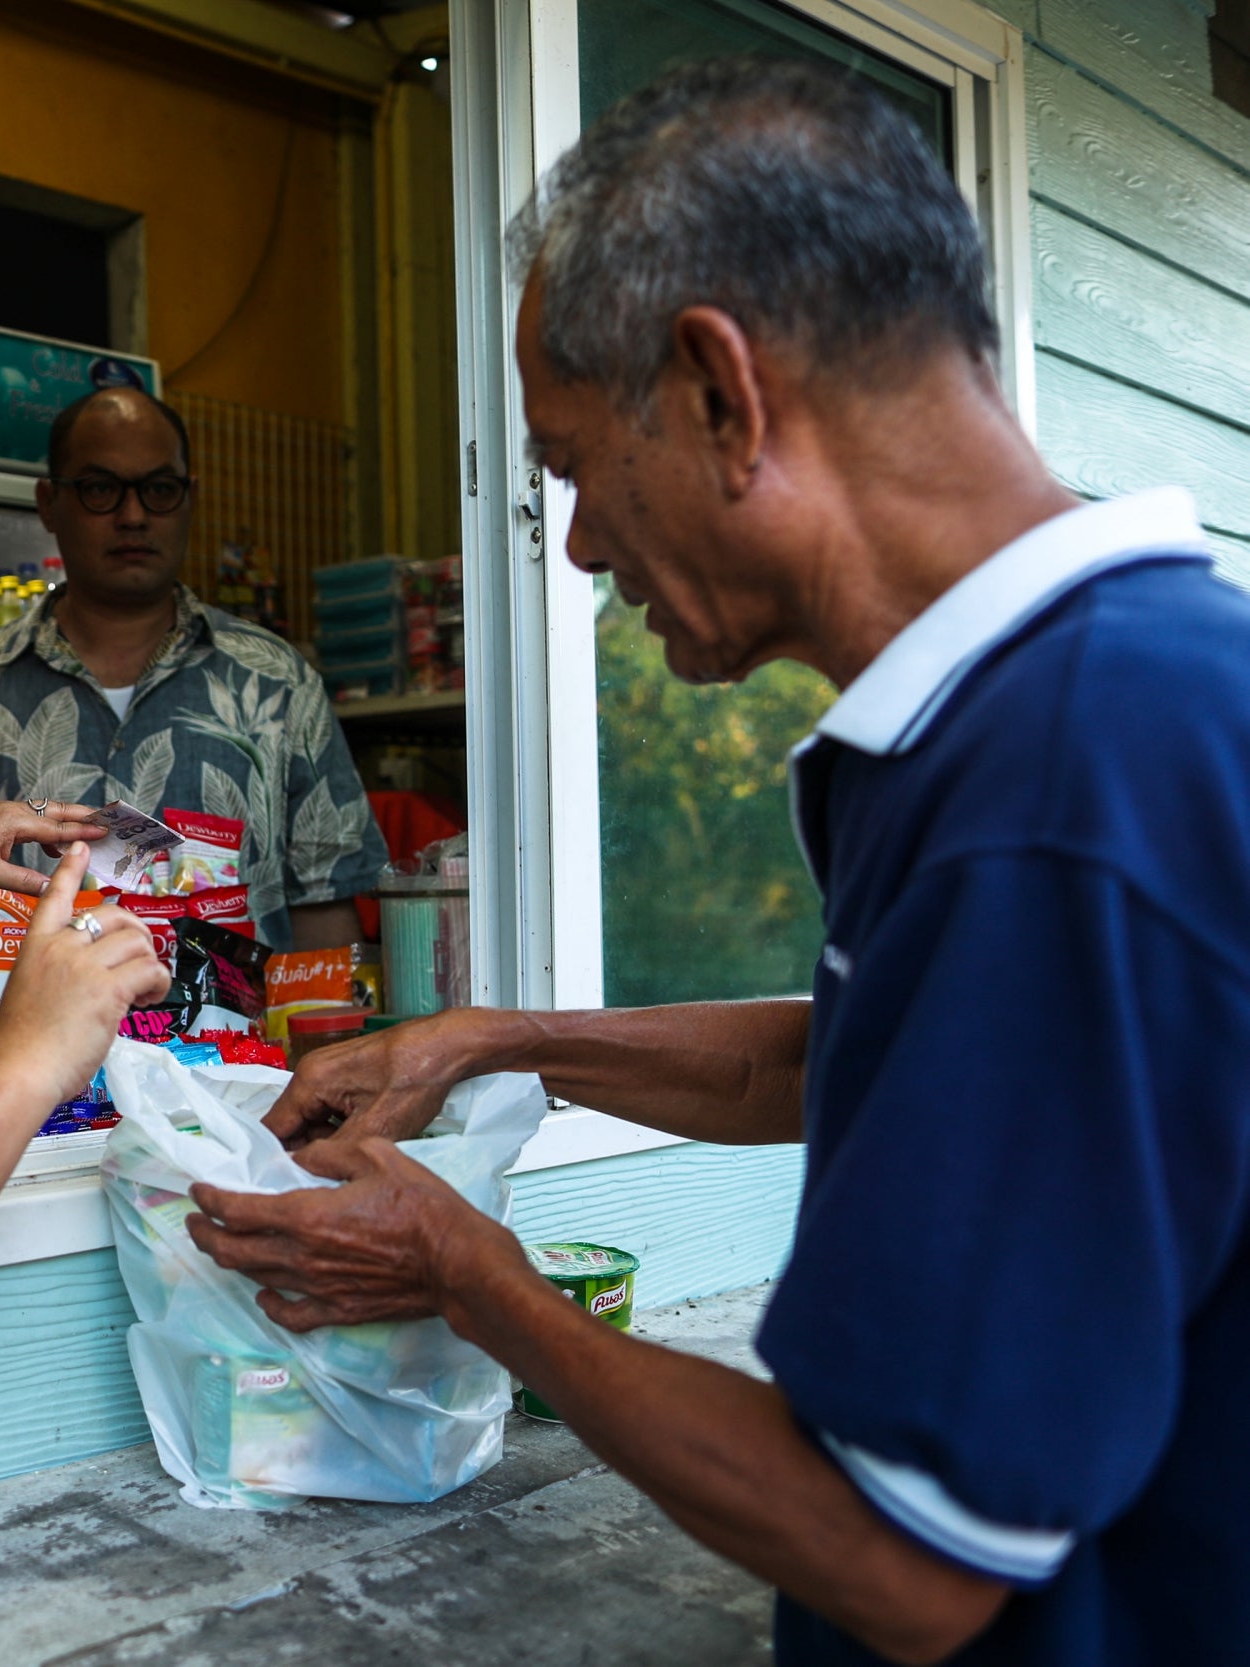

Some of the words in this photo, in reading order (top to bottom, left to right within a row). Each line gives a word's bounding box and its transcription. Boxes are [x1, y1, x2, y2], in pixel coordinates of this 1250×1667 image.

[176, 821, 238, 843] Dewberry
[197, 893, 247, 915] Dewberry
[593, 1286, 625, 1313] คนอร์
